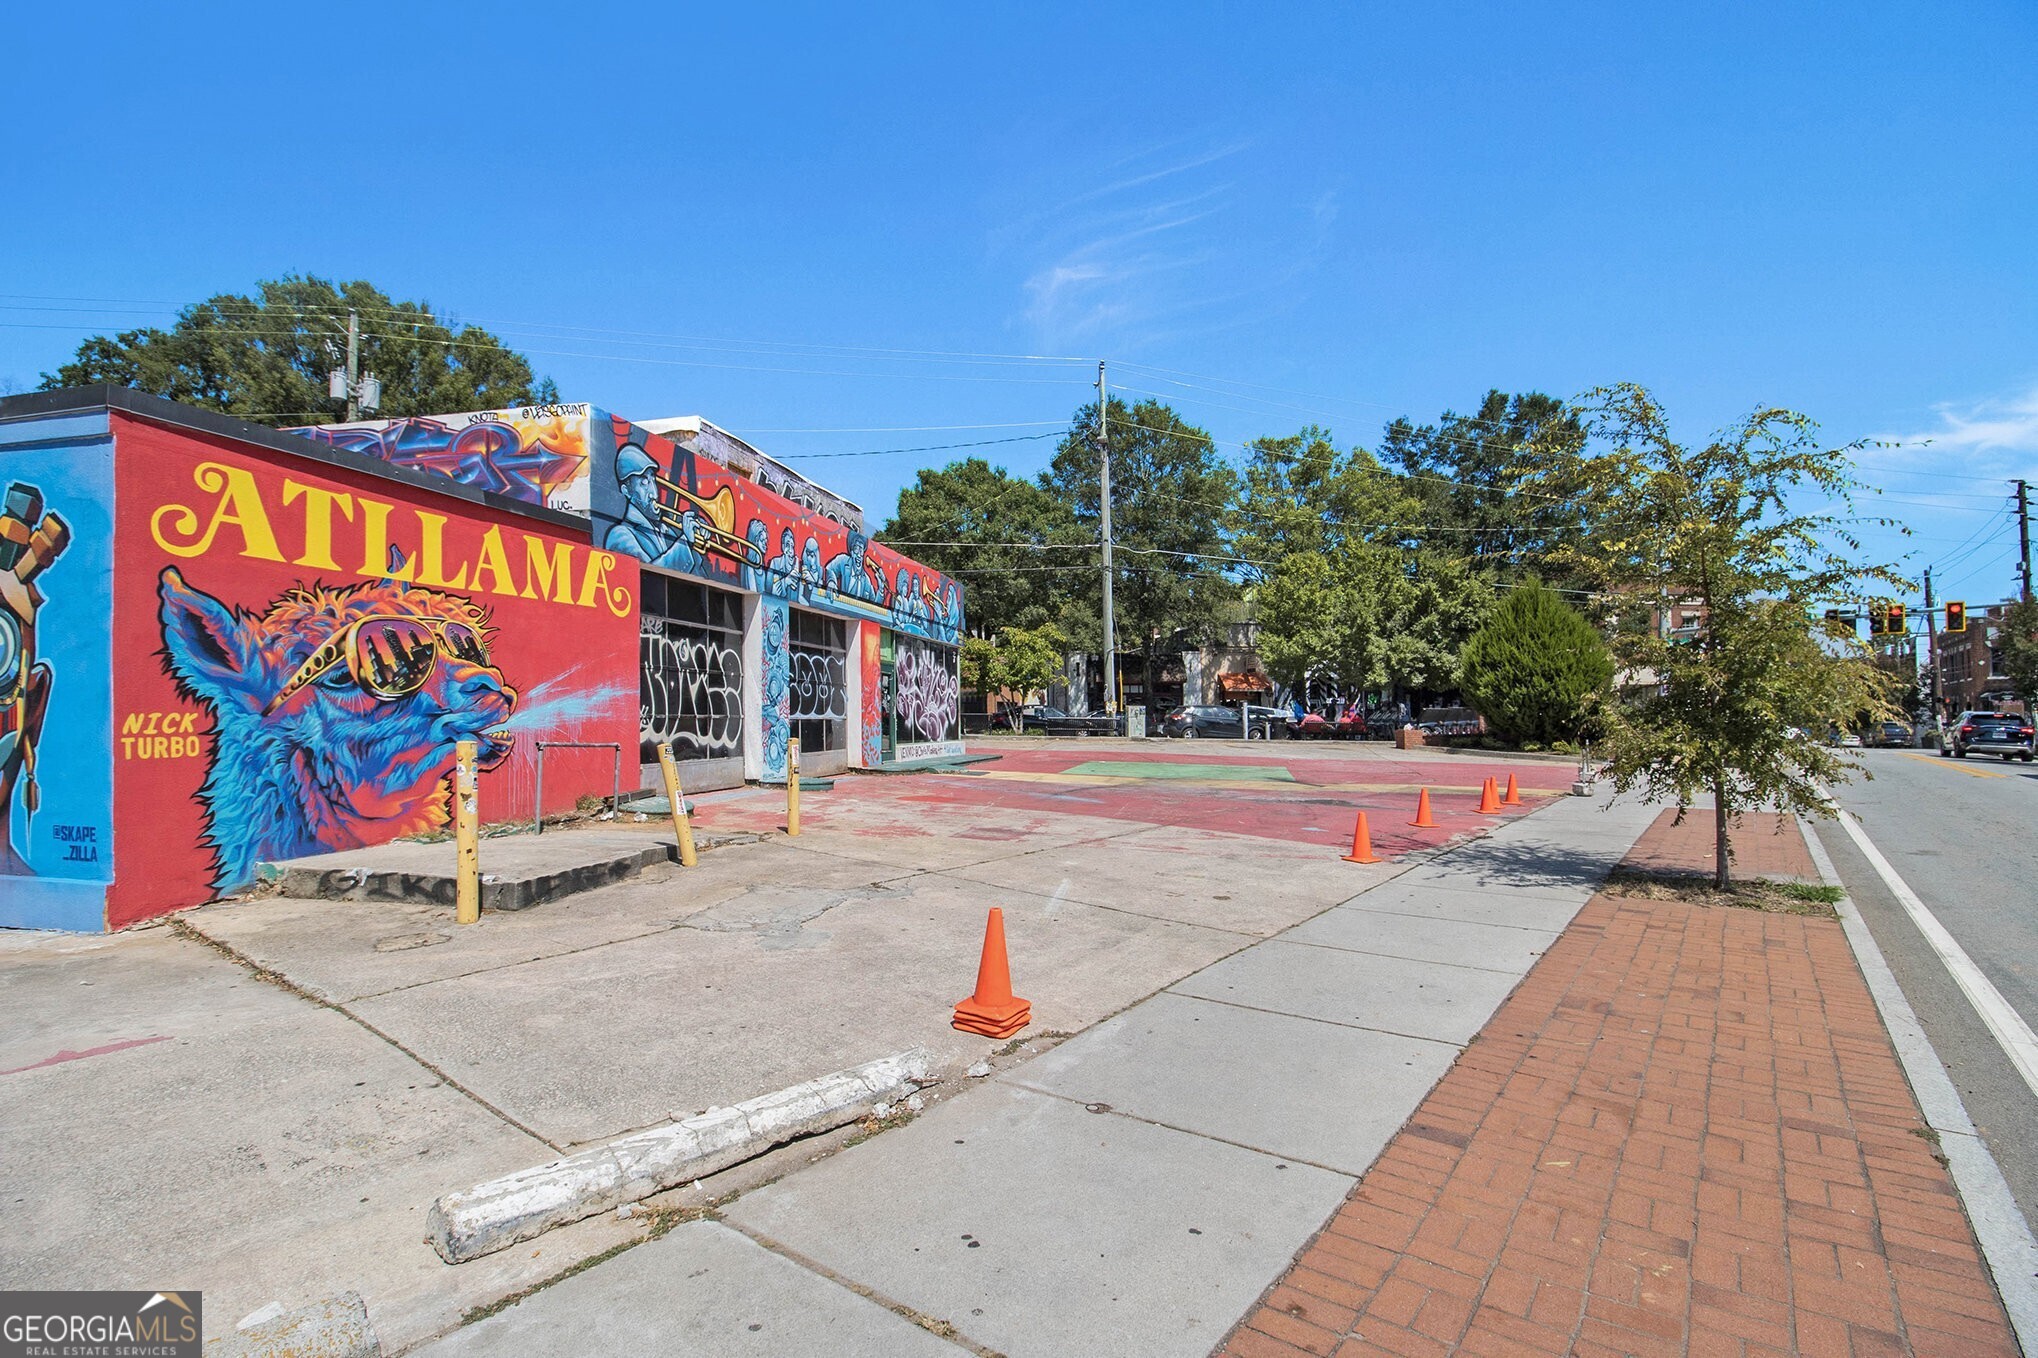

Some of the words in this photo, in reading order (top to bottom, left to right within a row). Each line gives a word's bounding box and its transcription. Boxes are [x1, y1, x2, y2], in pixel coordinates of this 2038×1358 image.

[151, 461, 632, 618] ATLLAMA
[122, 712, 199, 735] NICK
[121, 736, 200, 760] TURBO
[53, 825, 96, 842] @SKAPE
